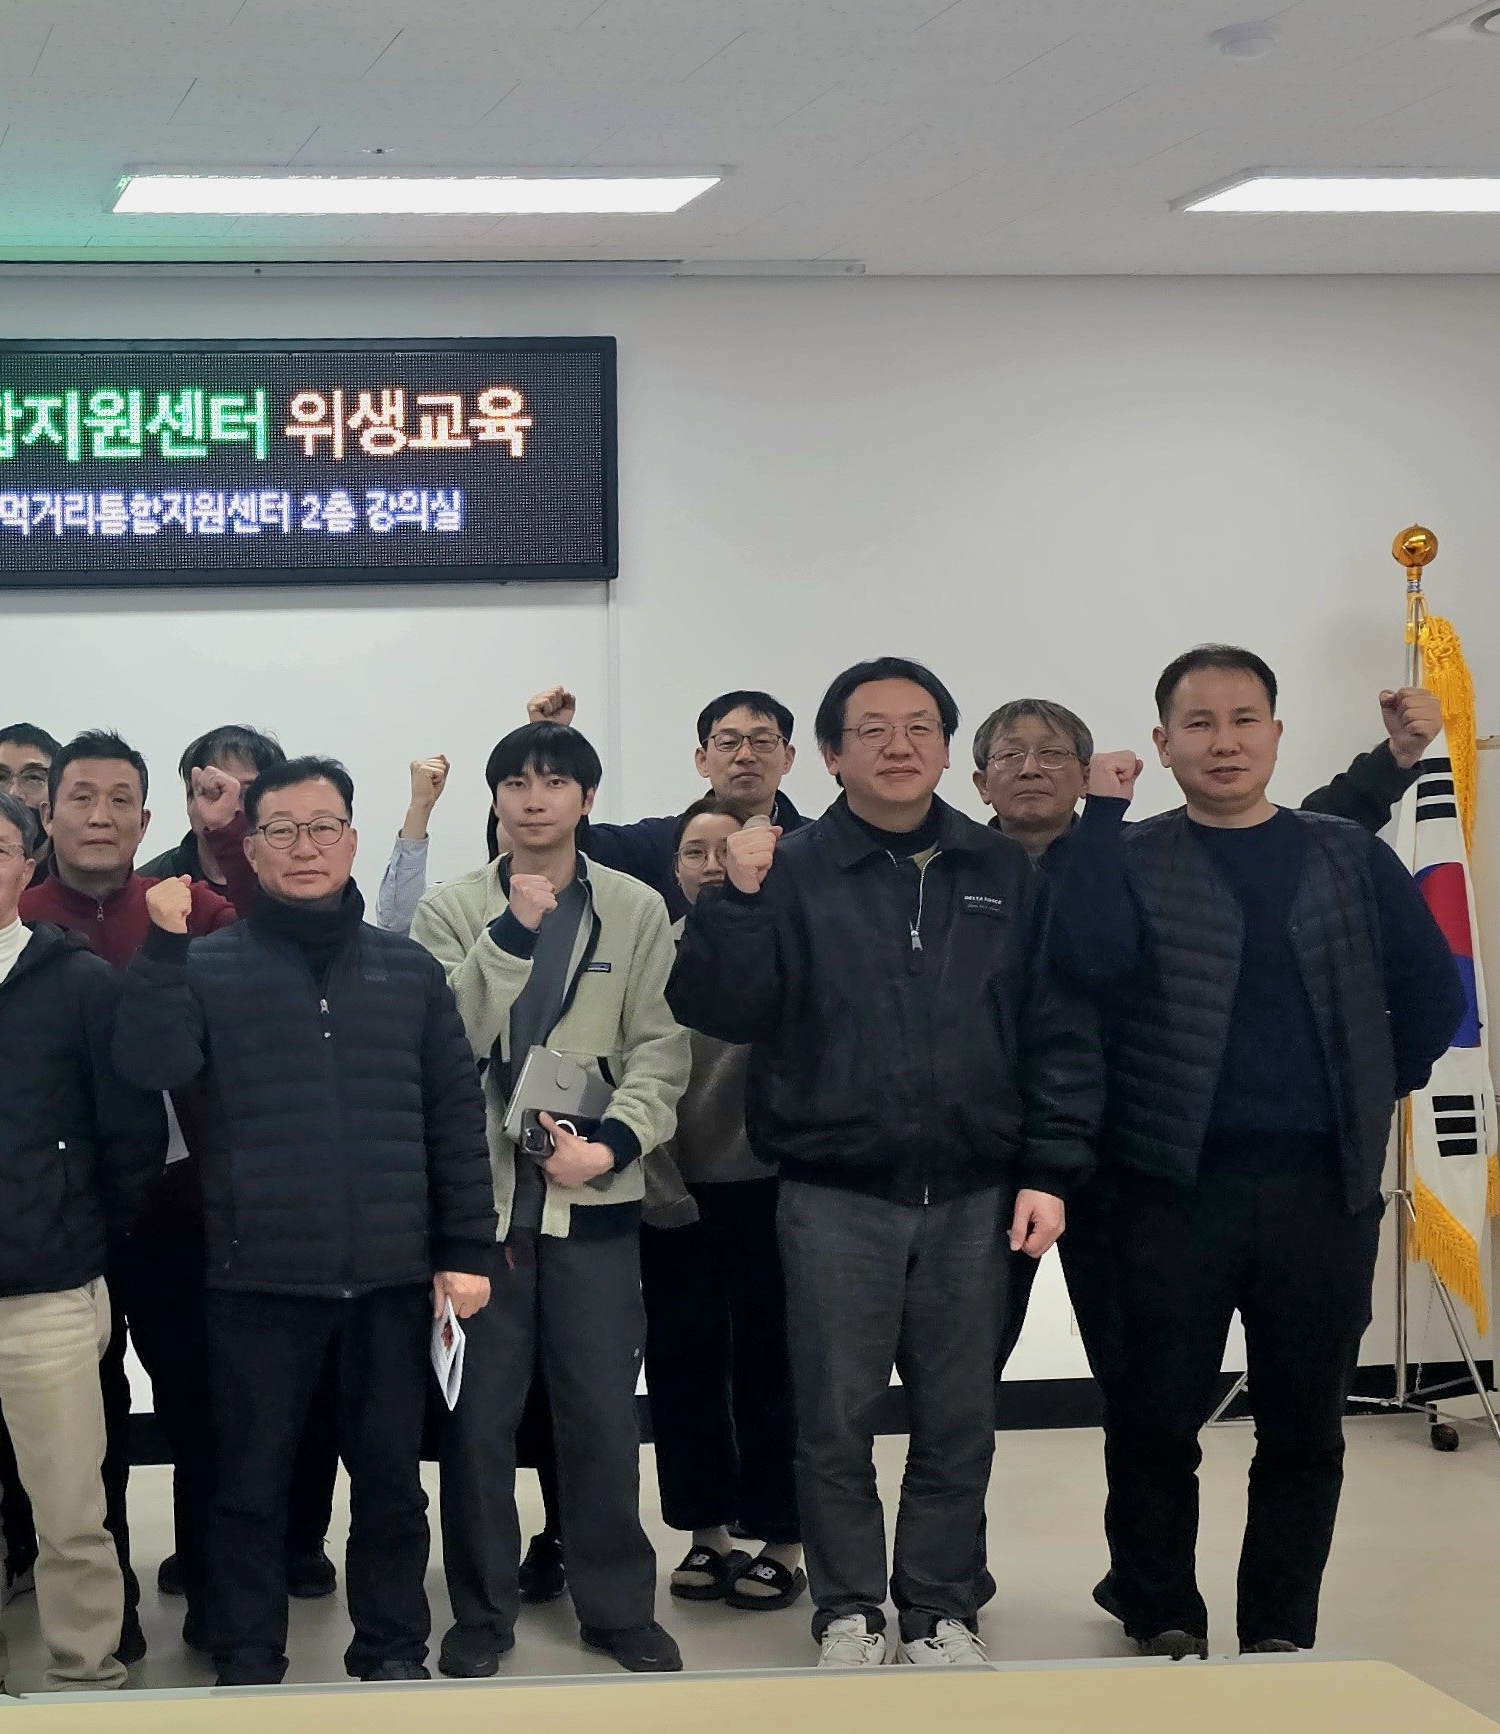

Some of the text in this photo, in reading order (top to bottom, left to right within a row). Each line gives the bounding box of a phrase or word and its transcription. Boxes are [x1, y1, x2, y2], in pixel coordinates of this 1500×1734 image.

[284, 386, 532, 459] 위생교육
[300, 489, 358, 534] 2층
[365, 488, 464, 533] 강의실
